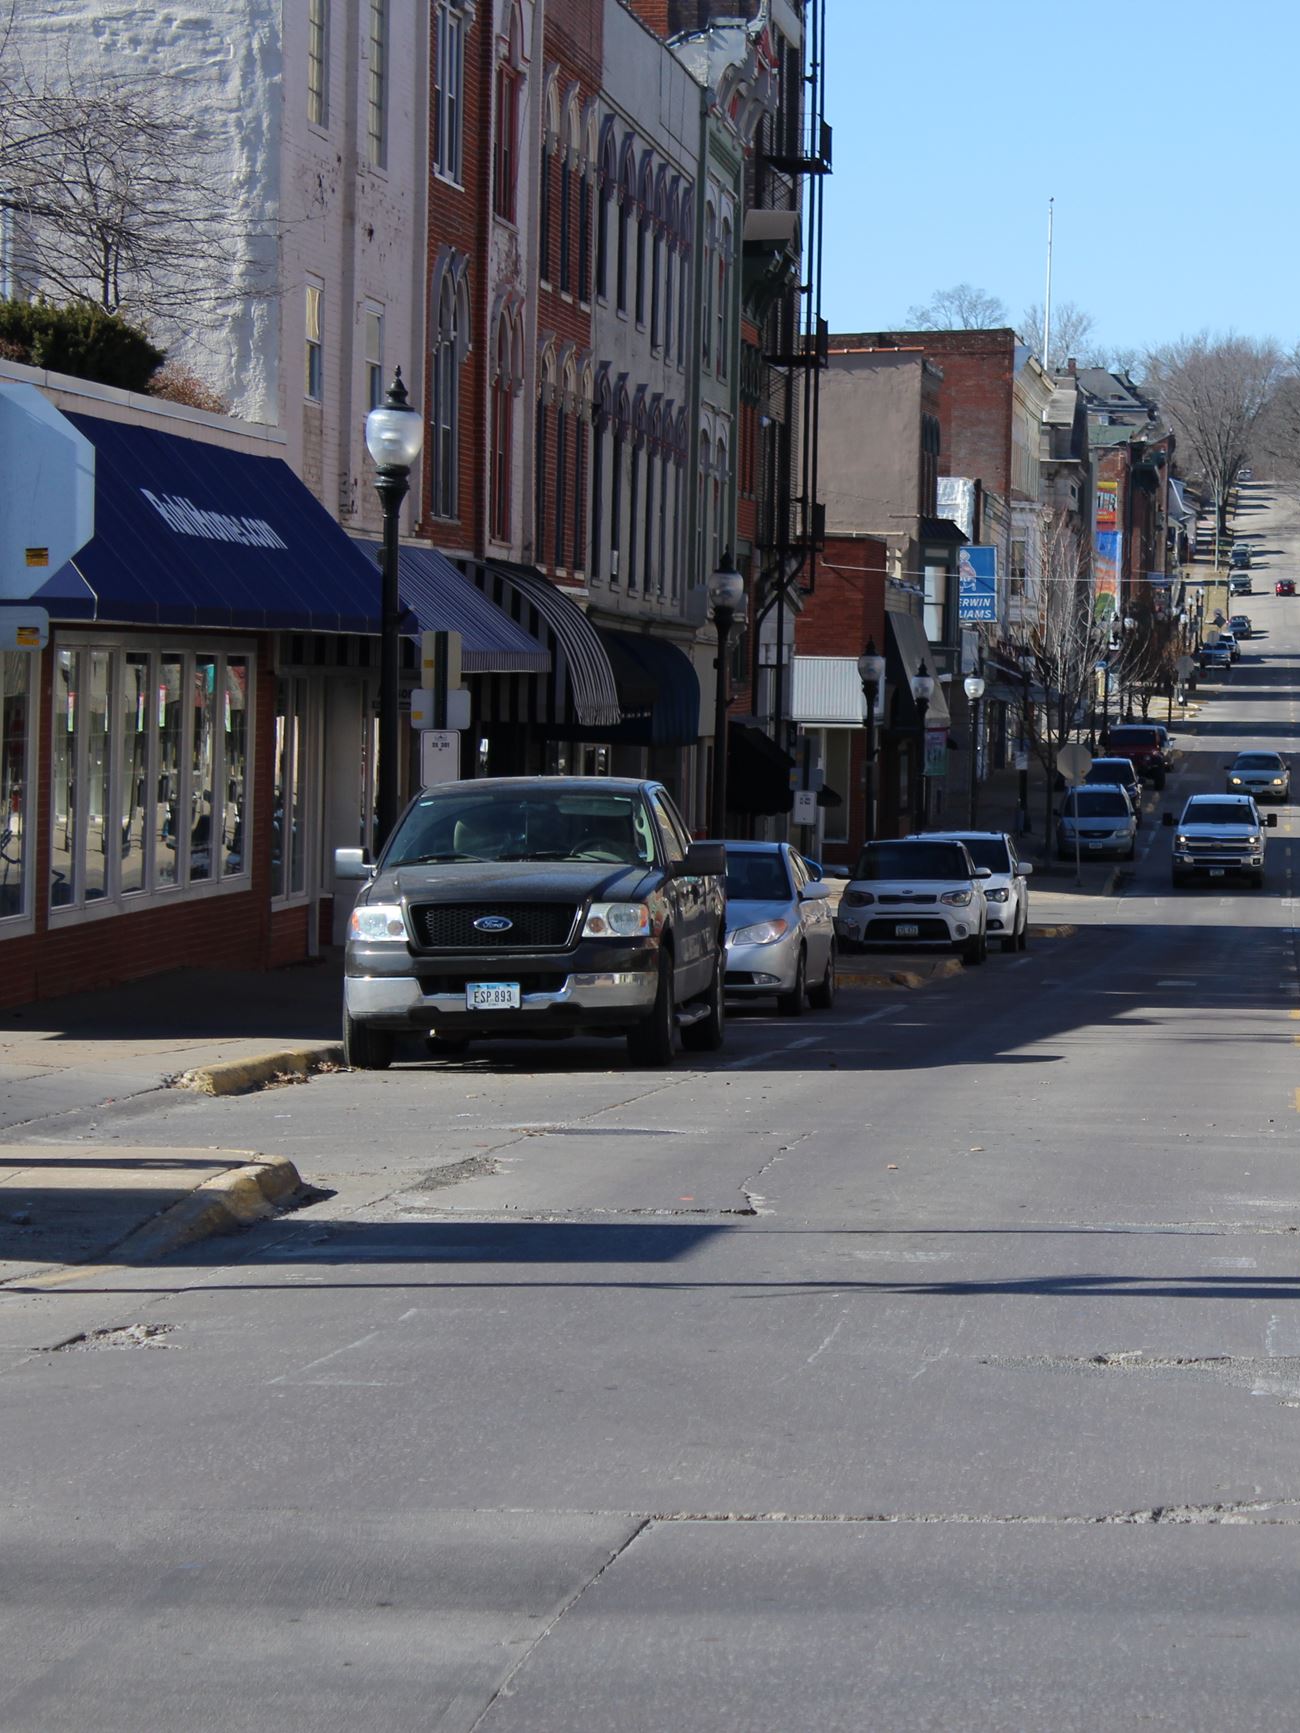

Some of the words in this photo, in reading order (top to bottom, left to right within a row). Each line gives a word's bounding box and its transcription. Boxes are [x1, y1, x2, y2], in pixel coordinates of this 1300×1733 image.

[483, 920, 504, 929] Ford
[473, 990, 492, 1003] ESP
[494, 990, 512, 1003] 893
